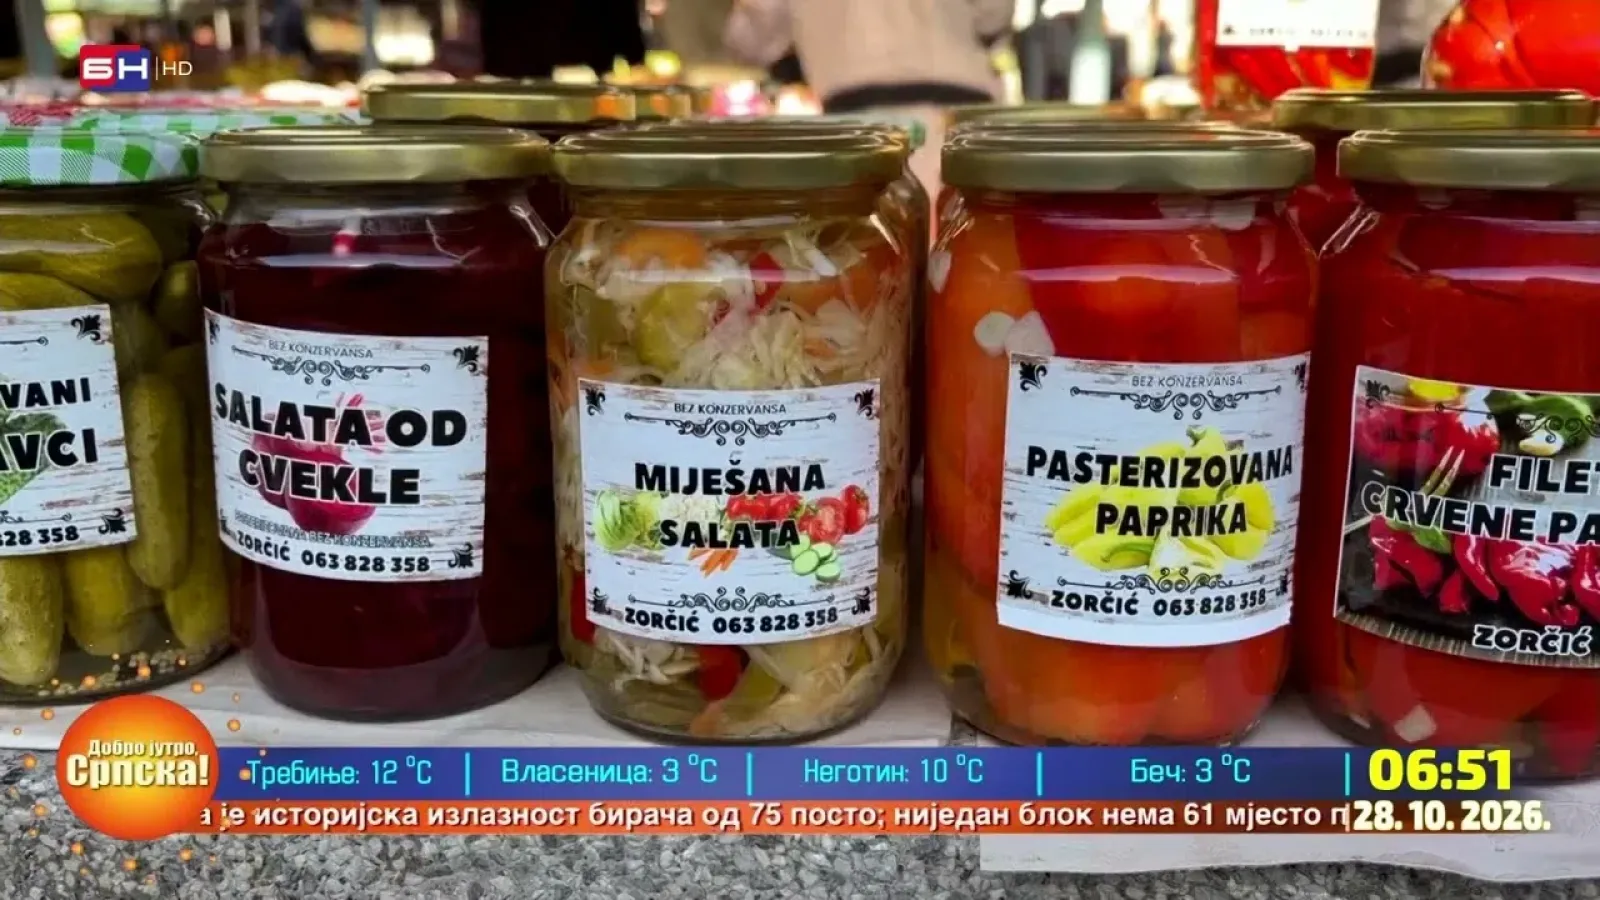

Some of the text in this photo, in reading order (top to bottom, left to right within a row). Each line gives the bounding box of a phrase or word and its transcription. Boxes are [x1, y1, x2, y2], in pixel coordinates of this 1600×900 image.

[268, 340, 374, 360] BEZ KONZERVANSA
[1132, 375, 1243, 387] BEZ KONZERVANSA
[215, 382, 468, 447] SALATA OD
[674, 403, 787, 415] BEZ KONZERVANSA
[238, 448, 421, 505] CVEKLE
[635, 459, 826, 496] MIJEŠANA
[1026, 445, 1293, 488] PASTERIZOVANA
[1096, 503, 1248, 537] PAPRIKA
[1361, 481, 1537, 542] CRVENE
[38, 525, 80, 544] 358
[660, 519, 800, 549] SALATA
[236, 529, 430, 573] ZORČIĆ 063 828 358
[1051, 588, 1267, 616] ZORČIĆ 063 828 358
[624, 606, 838, 634] ZORČIĆ 063 828 358
[1472, 625, 1593, 656] ZORČIĆ
